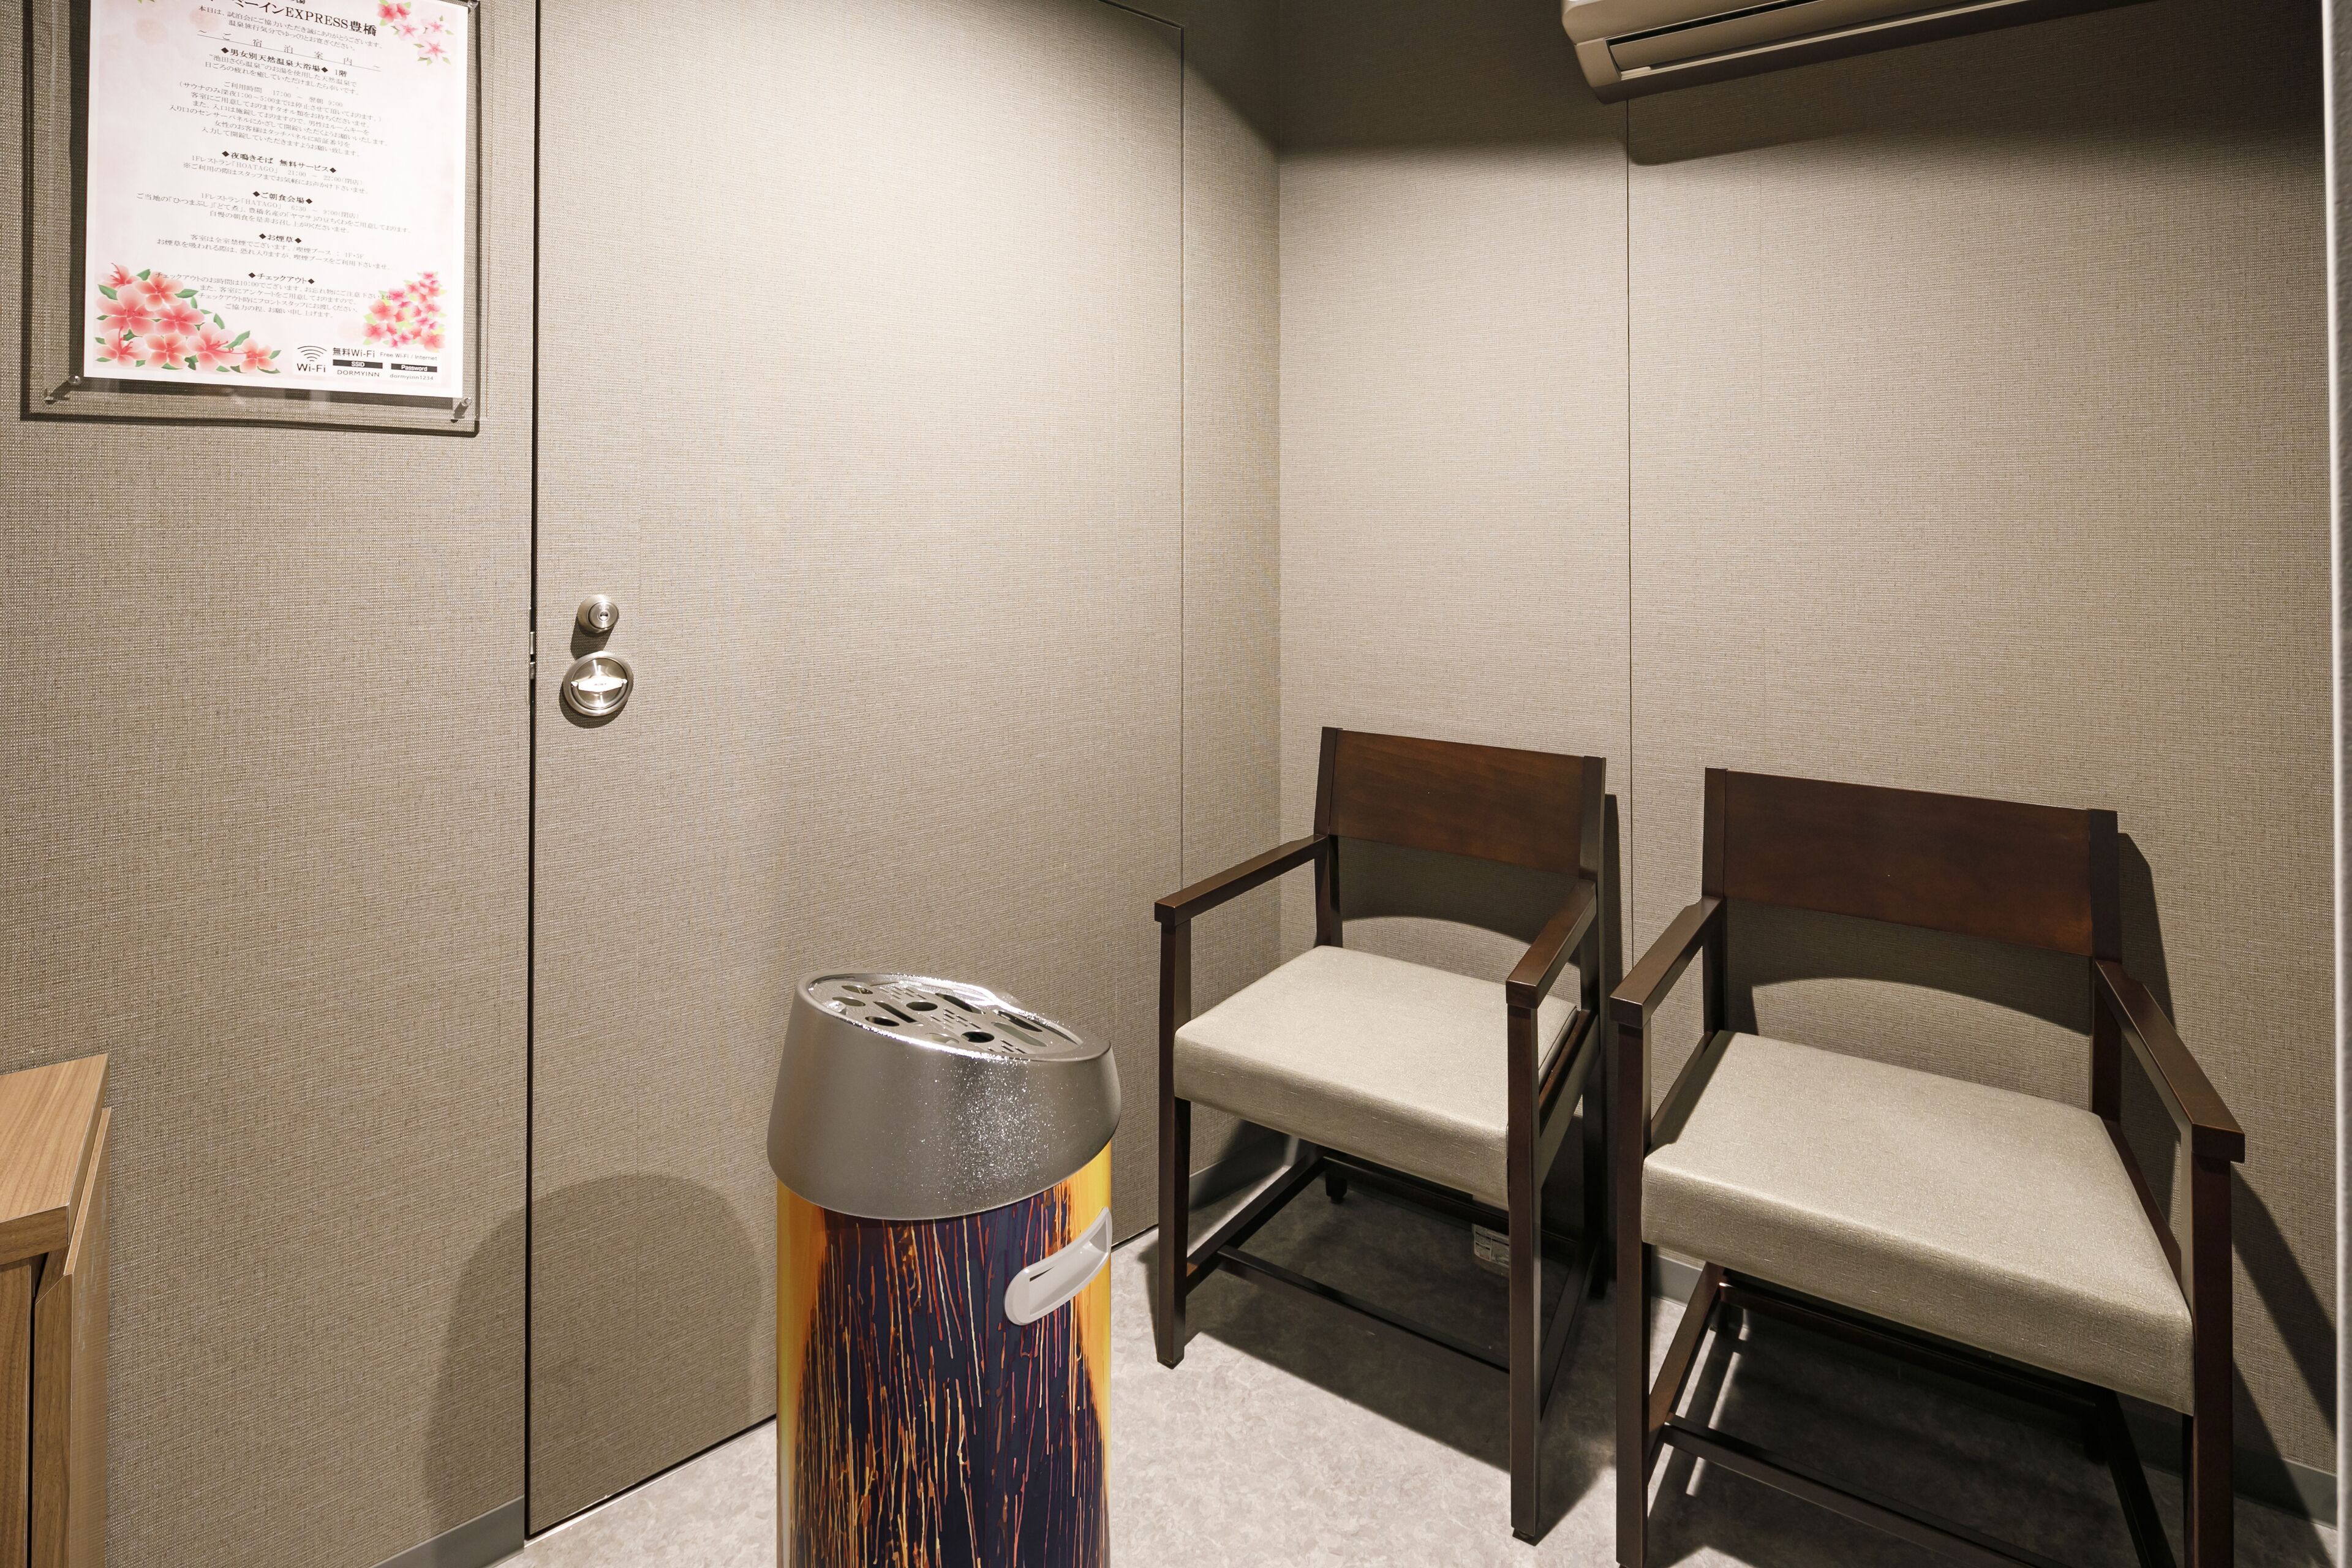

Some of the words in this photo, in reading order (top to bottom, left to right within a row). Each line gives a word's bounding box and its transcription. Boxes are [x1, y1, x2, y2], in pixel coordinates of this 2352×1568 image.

[210, 0, 377, 36] ミーインEXPRESS豊橋
[296, 363, 326, 372] Wi-Fi
